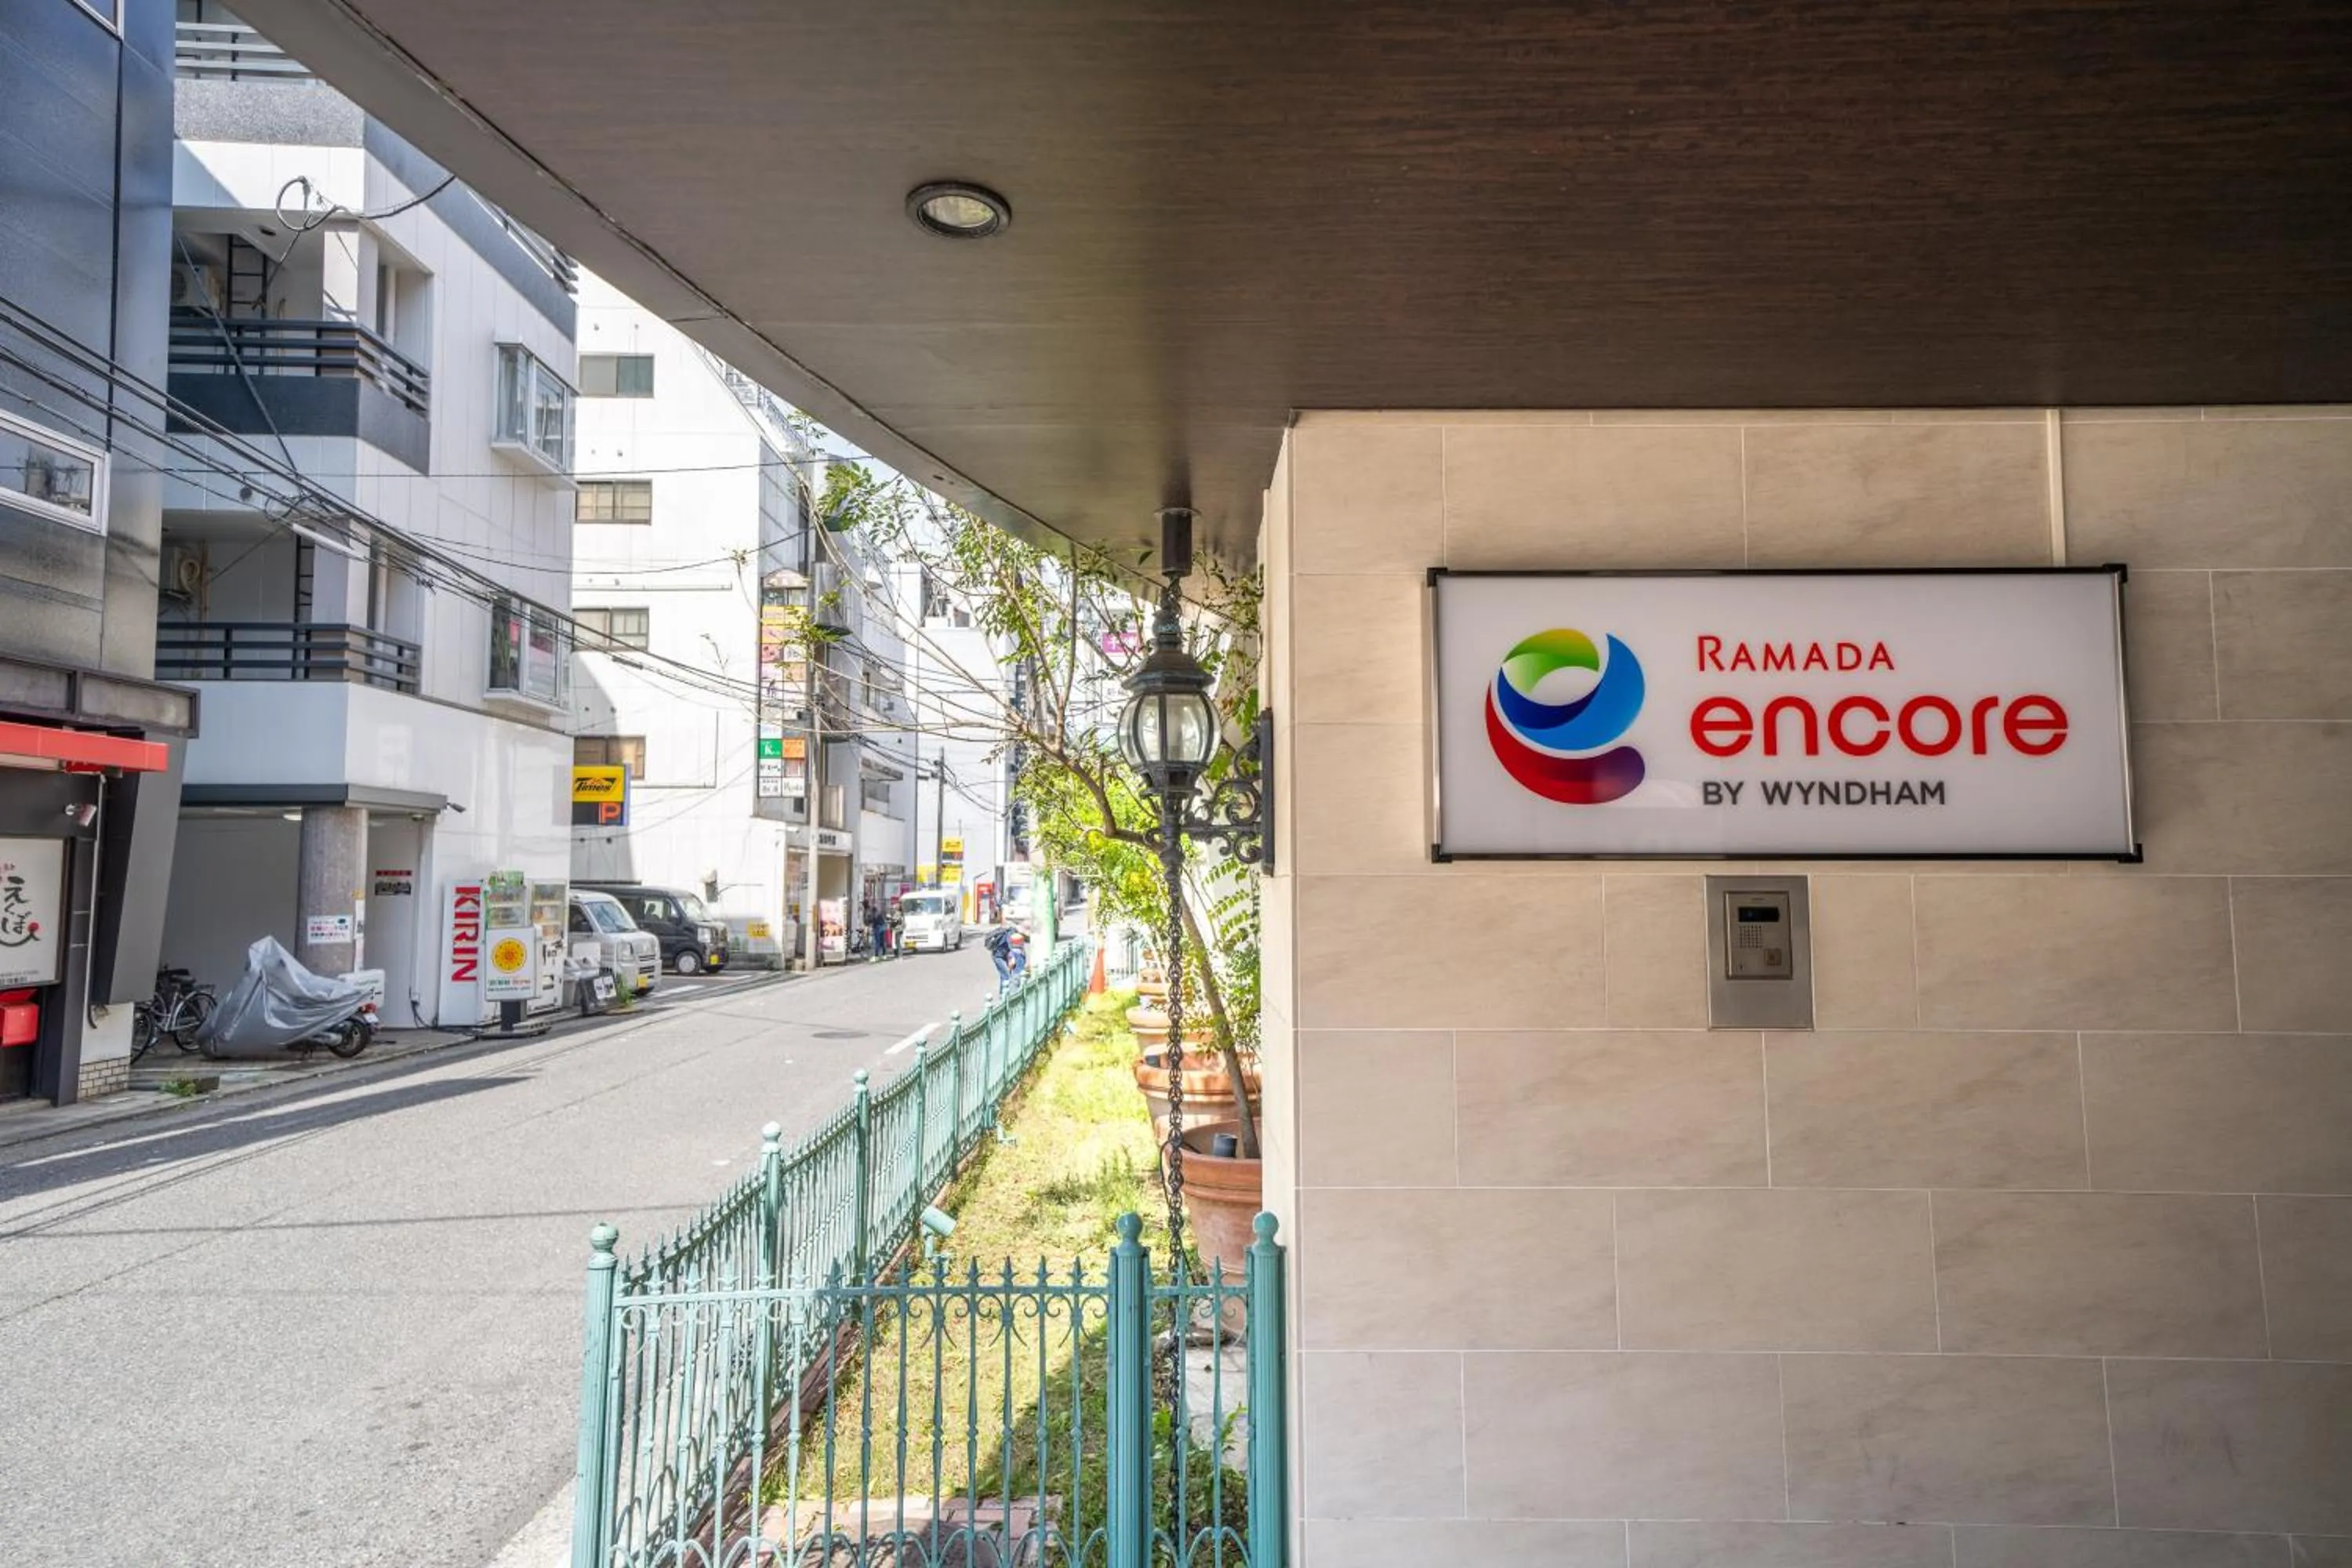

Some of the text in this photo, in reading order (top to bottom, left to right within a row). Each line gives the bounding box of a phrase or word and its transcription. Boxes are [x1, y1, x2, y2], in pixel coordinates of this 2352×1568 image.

[1690, 694, 2068, 757] encore
[1704, 781, 1946, 805] BY WYNDHAM
[451, 887, 481, 982] KIRIN
